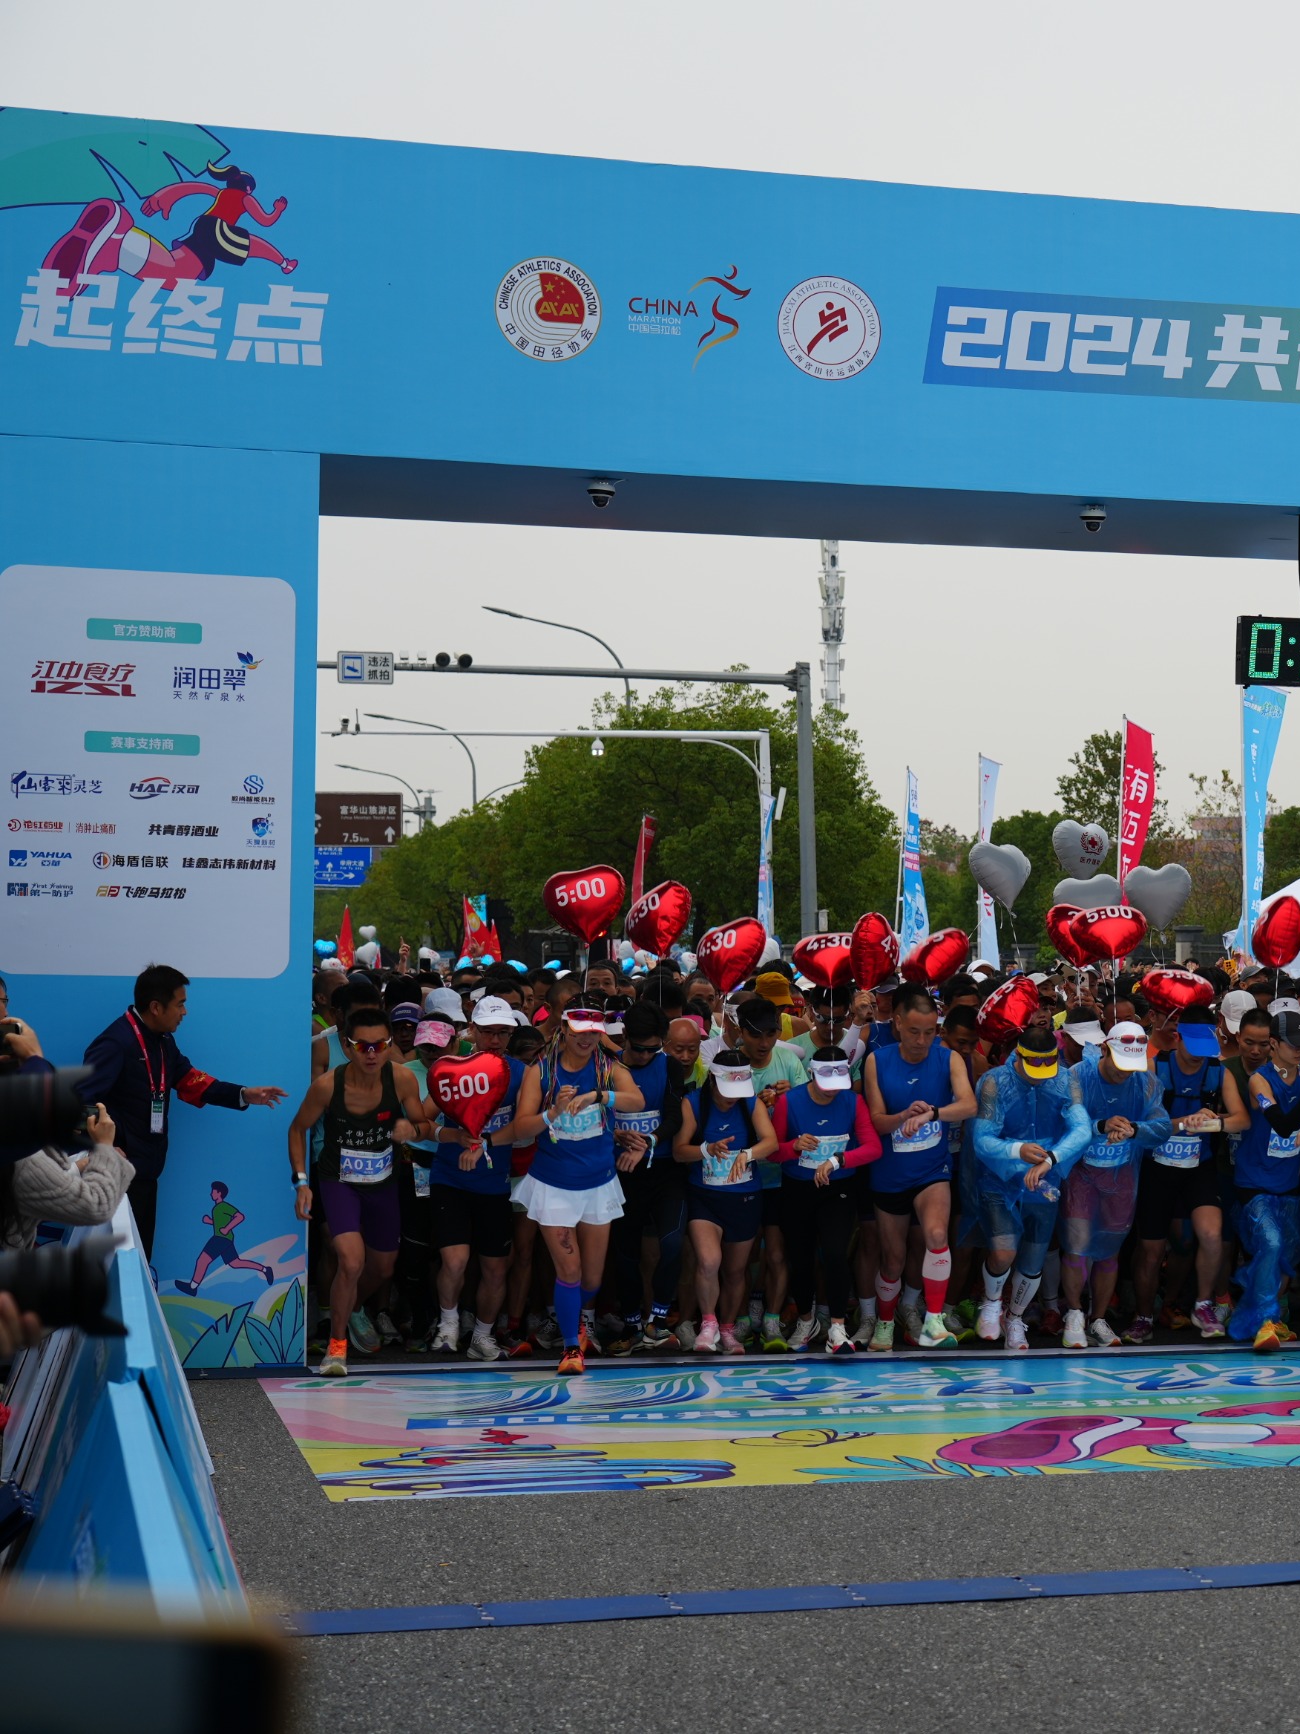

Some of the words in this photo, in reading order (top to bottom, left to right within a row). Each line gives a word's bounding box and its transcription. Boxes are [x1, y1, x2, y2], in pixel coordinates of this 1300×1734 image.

[498, 273, 518, 310] CHINESE
[517, 260, 562, 280] ATHLETICS
[563, 266, 598, 317] ASSOCIATION
[628, 297, 698, 318] CHINA
[796, 280, 839, 299] ATHLETIC
[840, 281, 878, 339] ASSOCIATION
[14, 269, 329, 367] 起终点
[628, 315, 681, 325] MARATHON
[628, 324, 681, 336] 中国马拉松
[504, 322, 594, 360] 中国田径协会
[786, 342, 872, 378] 江西省田径运动协会
[113, 623, 177, 639] 官方赞助商
[368, 656, 390, 667] 违法
[31, 660, 136, 682] 江中食疗
[173, 666, 246, 691] 润田翠
[368, 669, 390, 681] 抓拍
[172, 690, 246, 702] 天然矿泉水
[110, 736, 175, 750] 赛事支持商
[171, 784, 200, 795] 汉可
[340, 805, 396, 815] 富华山旅游区
[148, 823, 220, 838] 共青醇酒业
[30, 851, 73, 859] YAHUA
[112, 854, 169, 869] 海盾信联
[182, 857, 276, 871] 佳鑫志伟新材料
[122, 885, 187, 900] 飞跑马拉松
[555, 876, 607, 908] 5:00
[1086, 906, 1133, 924] 5:00
[806, 934, 852, 952] 4:30
[438, 1072, 491, 1102] 5:00
[342, 1157, 392, 1177] A0142
